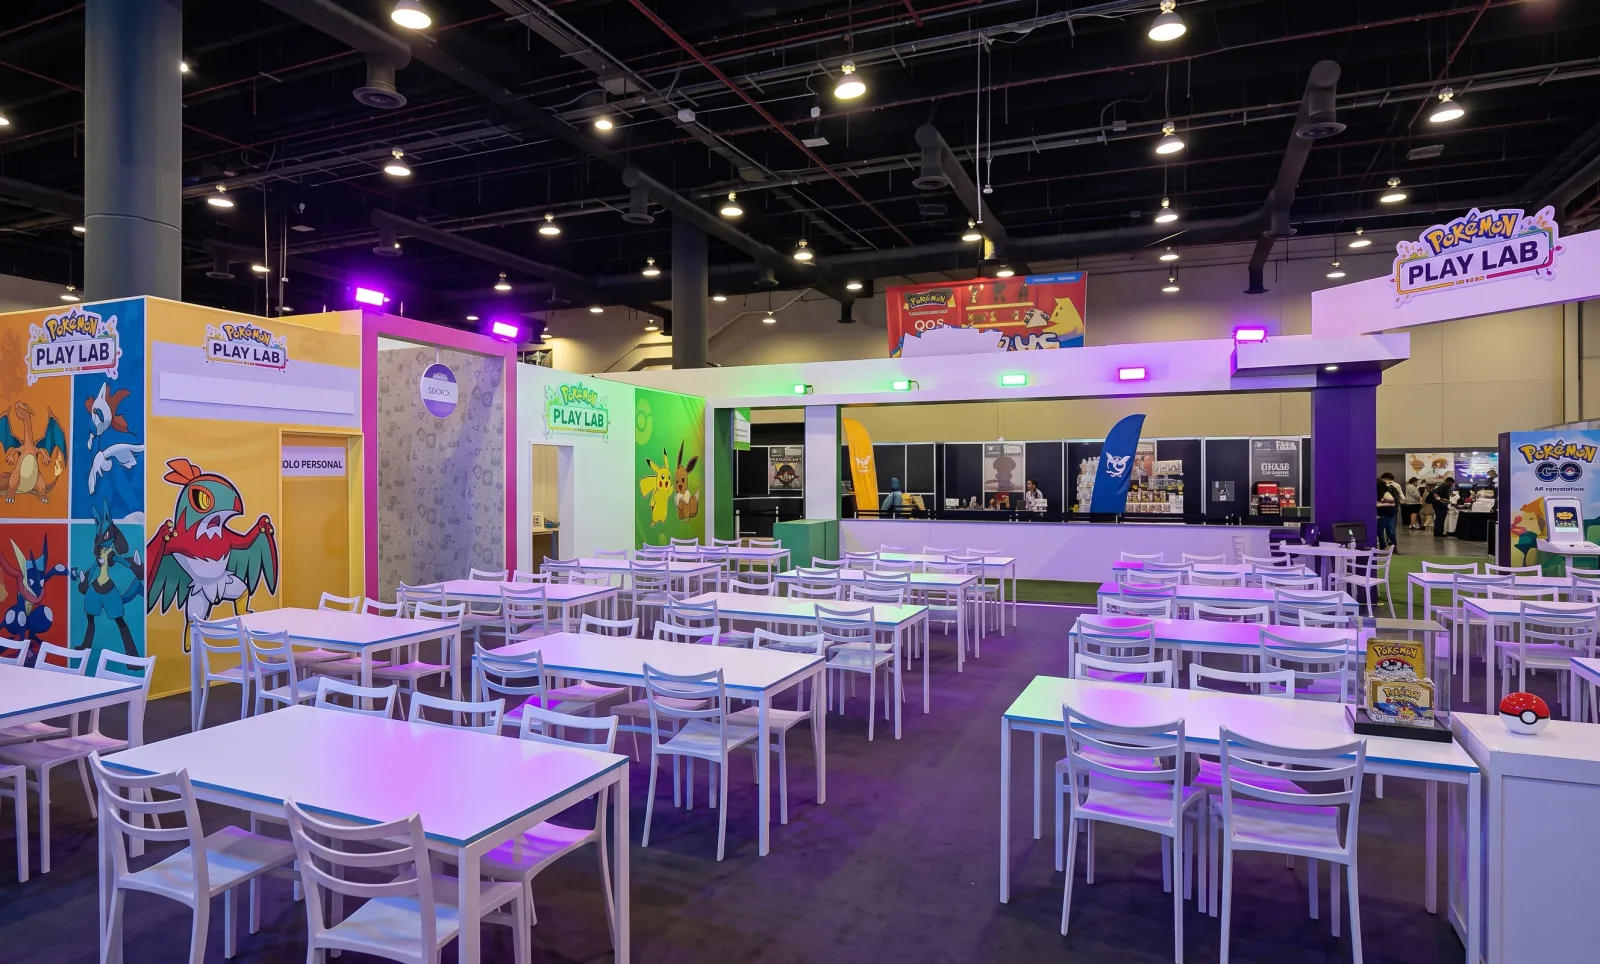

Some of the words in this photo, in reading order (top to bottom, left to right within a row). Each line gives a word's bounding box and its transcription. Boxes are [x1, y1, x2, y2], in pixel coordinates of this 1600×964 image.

[1423, 212, 1520, 256] Pokémon
[1408, 253, 1474, 286] PLAY
[1482, 240, 1539, 271] LAB
[45, 309, 100, 343] Pokémon
[36, 345, 75, 366] PLAY
[79, 342, 110, 363] LAB
[213, 342, 250, 360] PLAY
[253, 348, 280, 364] LAB
[553, 408, 583, 426] PLAY
[584, 411, 604, 428] LAB
[1517, 439, 1598, 465] Pokémon
[281, 460, 300, 469] OLO
[301, 460, 344, 469] PERSONAL
[1535, 461, 1583, 482] GO
